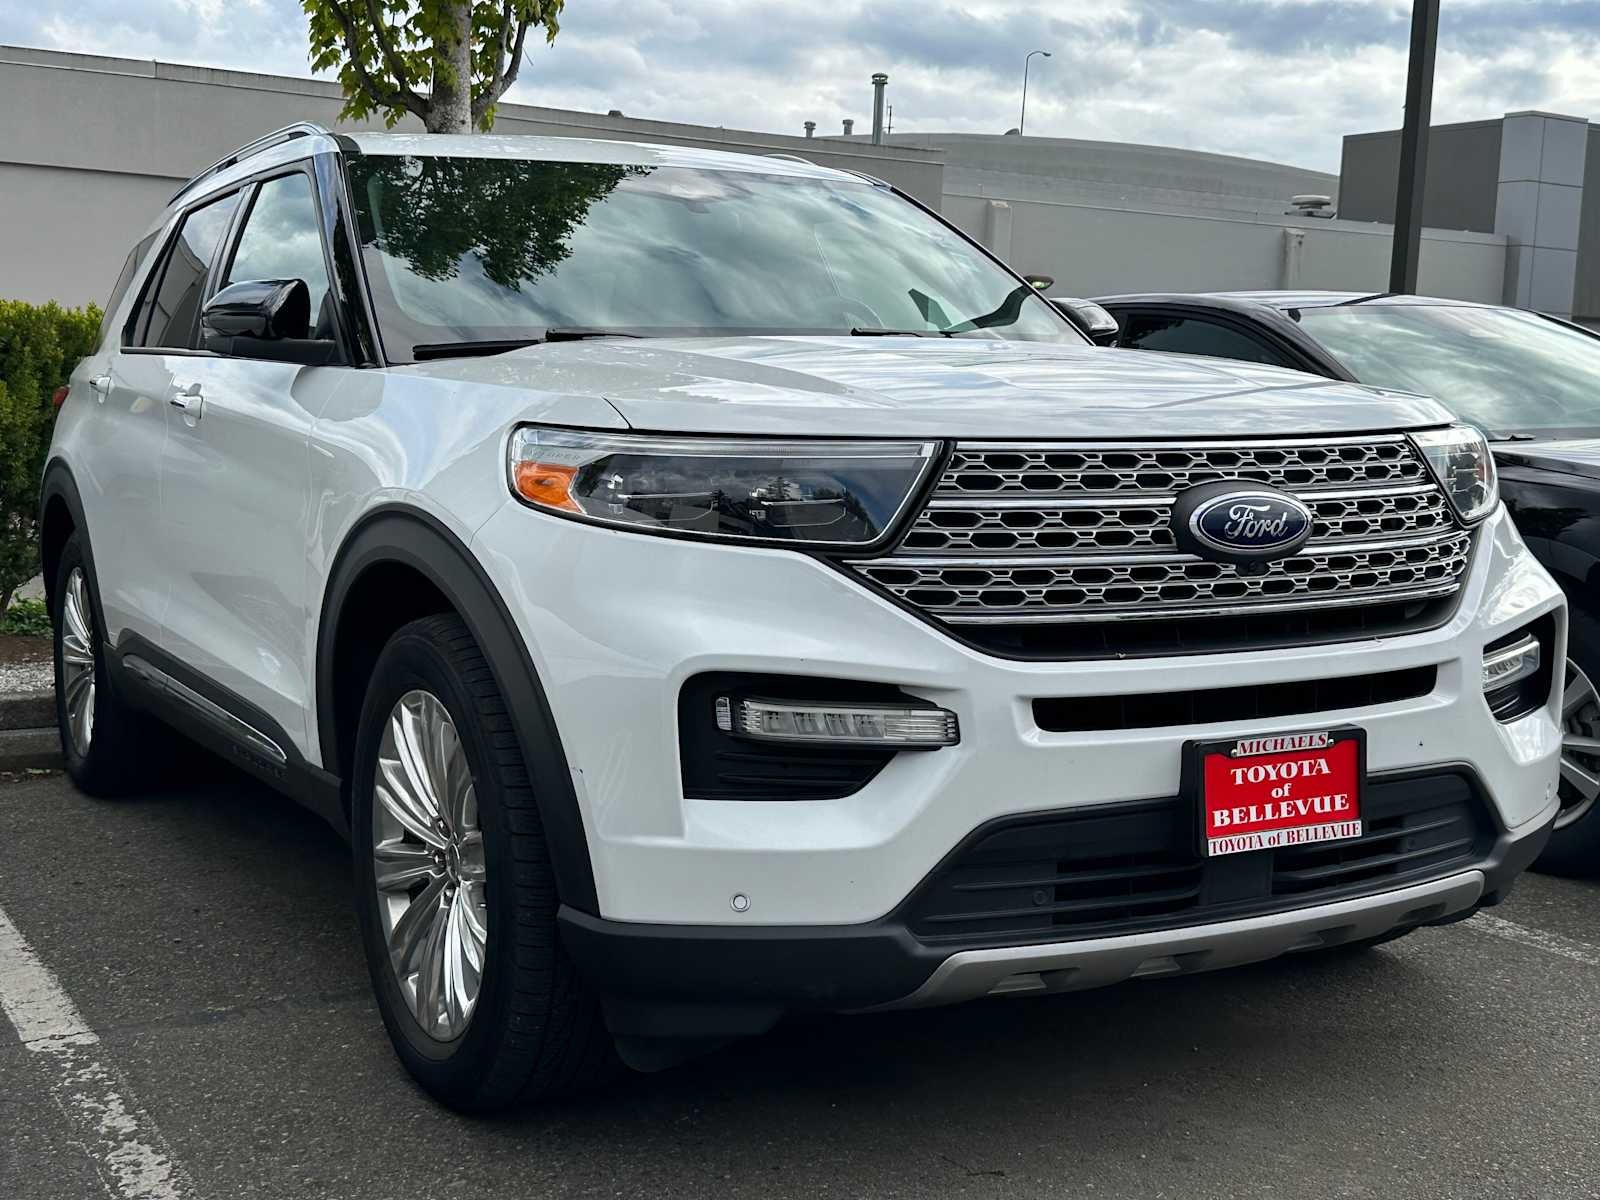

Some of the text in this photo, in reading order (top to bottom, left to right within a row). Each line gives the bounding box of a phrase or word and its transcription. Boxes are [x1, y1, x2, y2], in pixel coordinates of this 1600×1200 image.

[1224, 504, 1288, 539] Ford
[1239, 733, 1327, 755] MICHAELS
[1230, 758, 1331, 785] TOYOTA
[1271, 783, 1292, 798] of
[1212, 793, 1350, 828] BELLEVUE
[1210, 822, 1361, 855] TOYOTA of BELLEVUE
